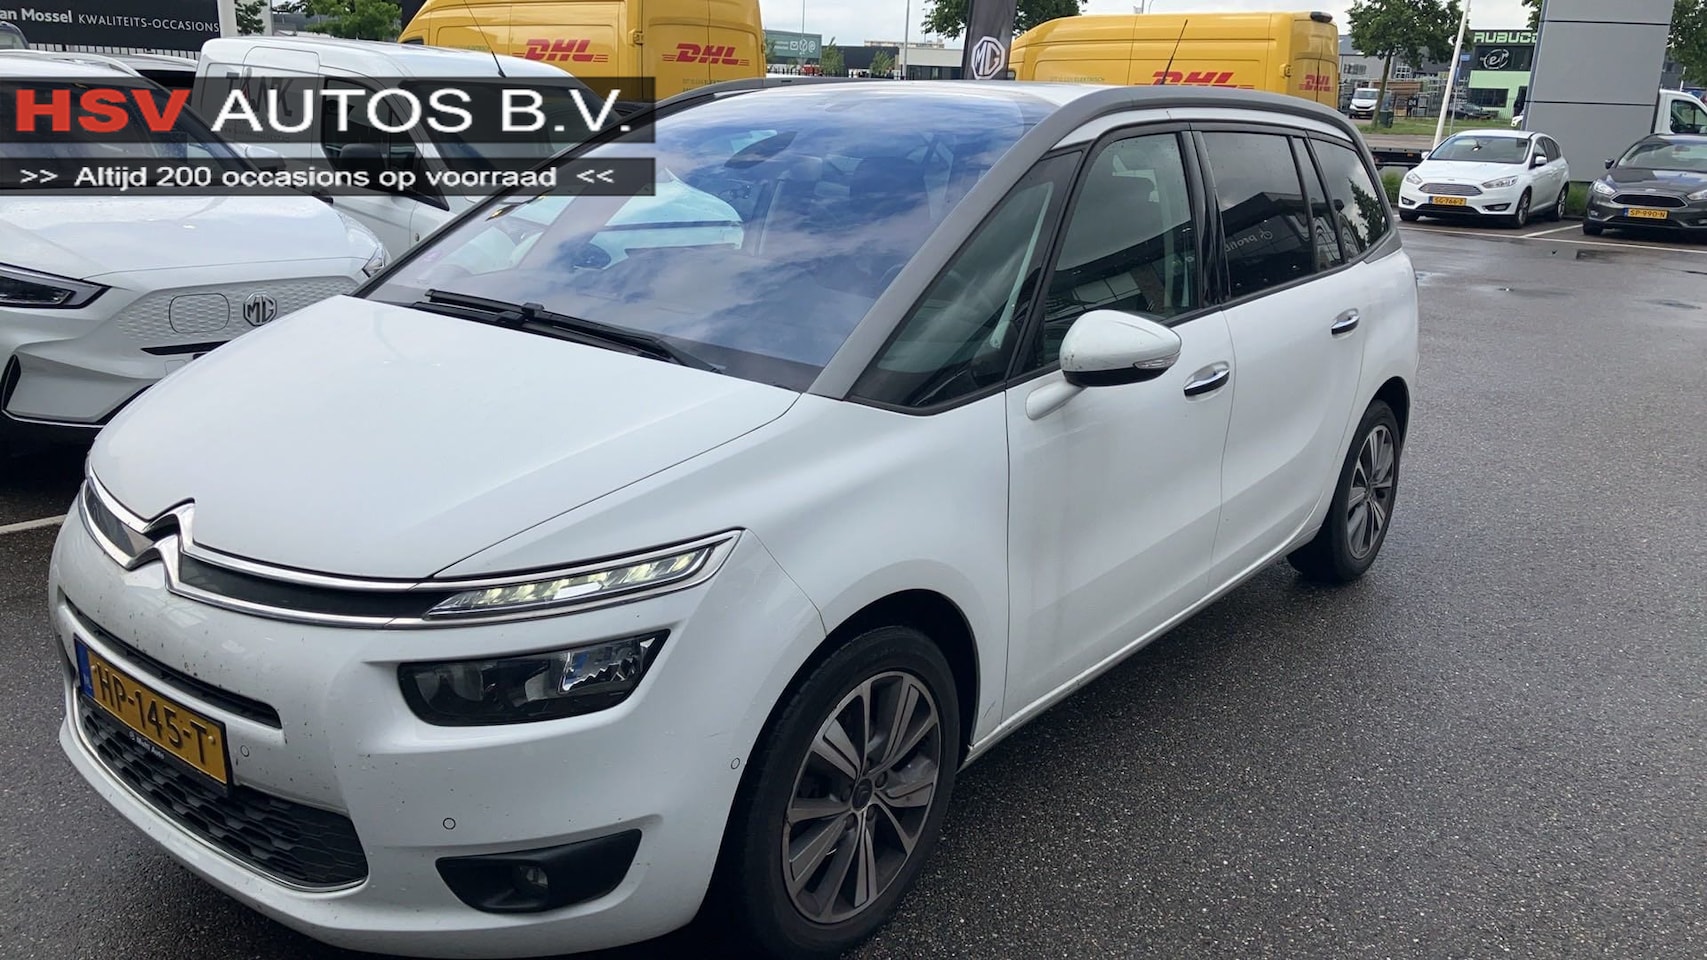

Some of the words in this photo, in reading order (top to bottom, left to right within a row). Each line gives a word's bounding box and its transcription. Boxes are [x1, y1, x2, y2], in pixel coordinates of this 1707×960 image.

[20, 8, 73, 23] Mossel
[78, 14, 220, 32] KWALITEITS-OCCASIONS
[525, 39, 594, 62] DHL
[676, 43, 739, 65] DHL
[973, 39, 1002, 78] MG
[1303, 74, 1334, 92] DHL
[245, 294, 275, 325] MG
[97, 662, 208, 766] HP-145-T
